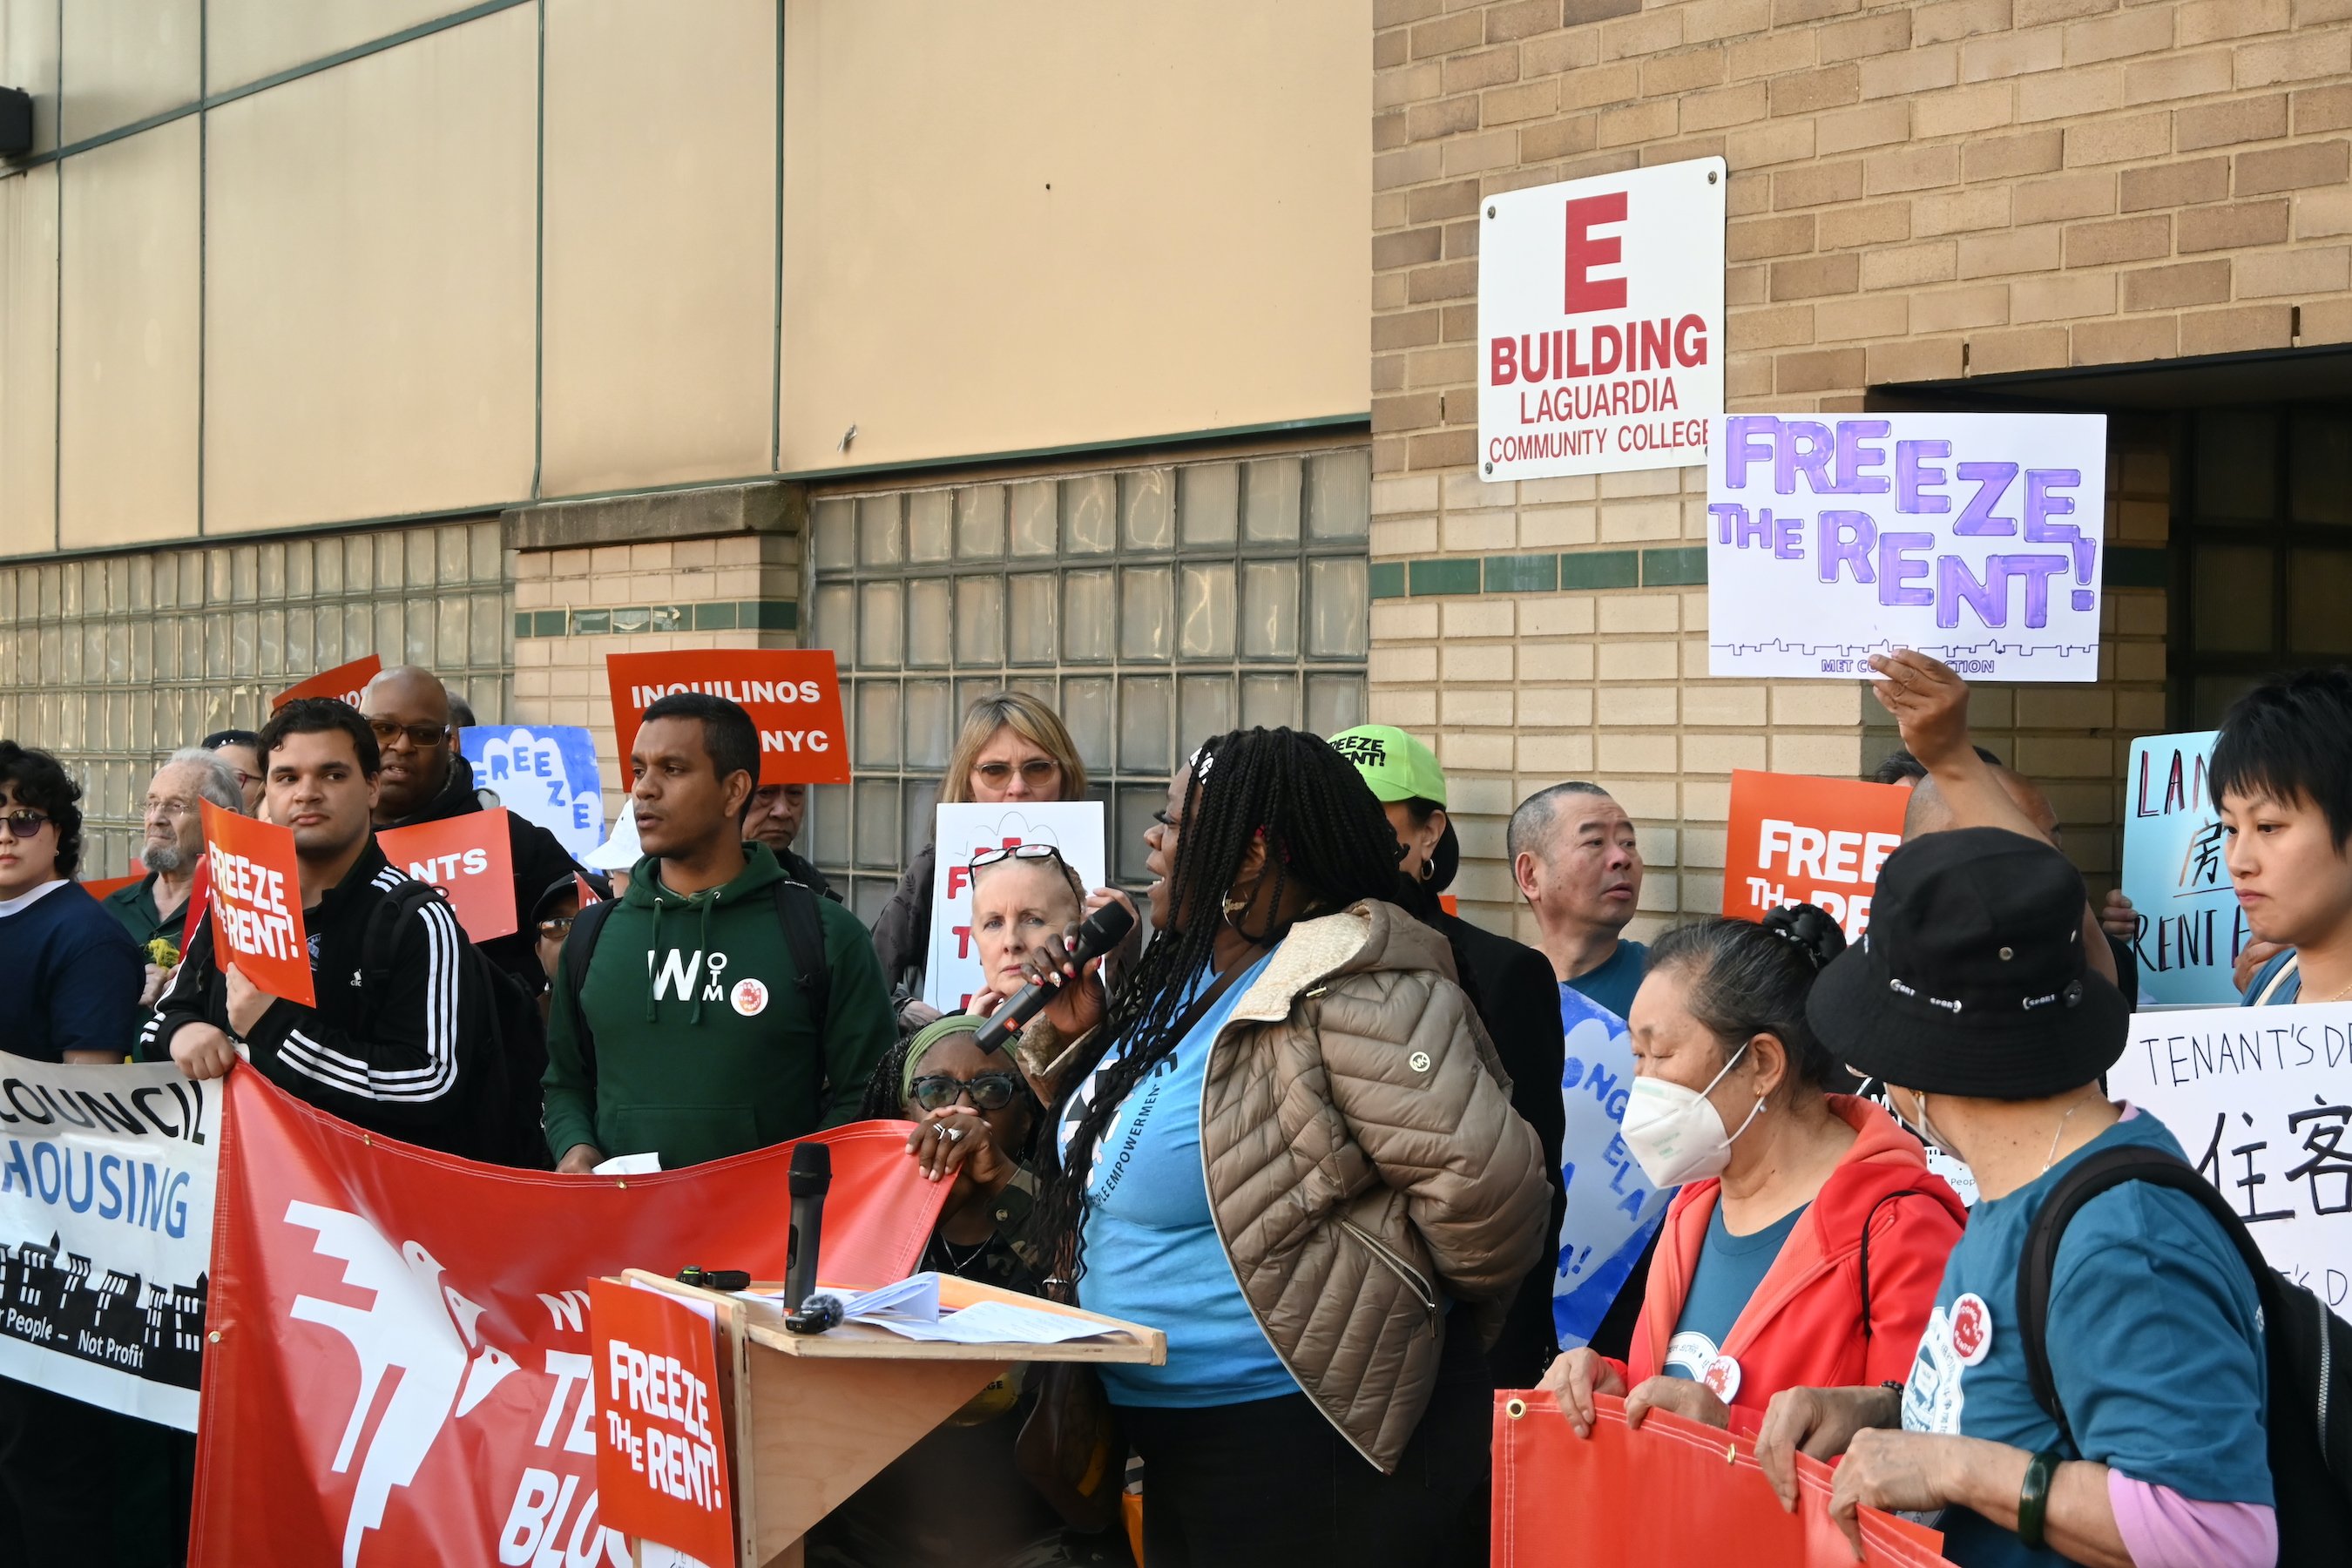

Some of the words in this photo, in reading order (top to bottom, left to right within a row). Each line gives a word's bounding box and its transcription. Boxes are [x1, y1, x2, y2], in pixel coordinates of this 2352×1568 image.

[1565, 191, 1628, 314] E
[1490, 313, 1707, 386] BUILDING
[1520, 376, 1679, 424] LAGUARDIA
[1490, 428, 1608, 463] COMMUNITY
[1725, 416, 2081, 544] FREEZE
[1708, 503, 1805, 559] THE
[1817, 510, 2096, 629] RENT!
[1821, 659, 1853, 672] MET
[1944, 659, 1995, 673] TION
[760, 730, 828, 753] NYC
[1329, 736, 1384, 752] REEZE
[1341, 751, 1386, 767] ENT!
[208, 840, 288, 916] FREEZE
[1758, 818, 1902, 884] FREE
[2179, 816, 2222, 887] 房
[212, 889, 228, 935] THE
[226, 903, 299, 961] RENT!
[2139, 1023, 2315, 1087] TENANT'S
[2324, 1023, 2352, 1069] D
[1106, 1084, 1160, 1192] EMPOWERMEN
[2198, 1094, 2352, 1224] 住客
[1, 1139, 191, 1240] HOUSING
[1950, 1178, 1976, 1186] Peop
[6, 1308, 53, 1342] People
[78, 1329, 104, 1357] Not
[105, 1337, 145, 1369] Profit
[609, 1338, 713, 1447] FREEZE
[606, 1409, 645, 1472] THE
[646, 1427, 722, 1512] RENT!
